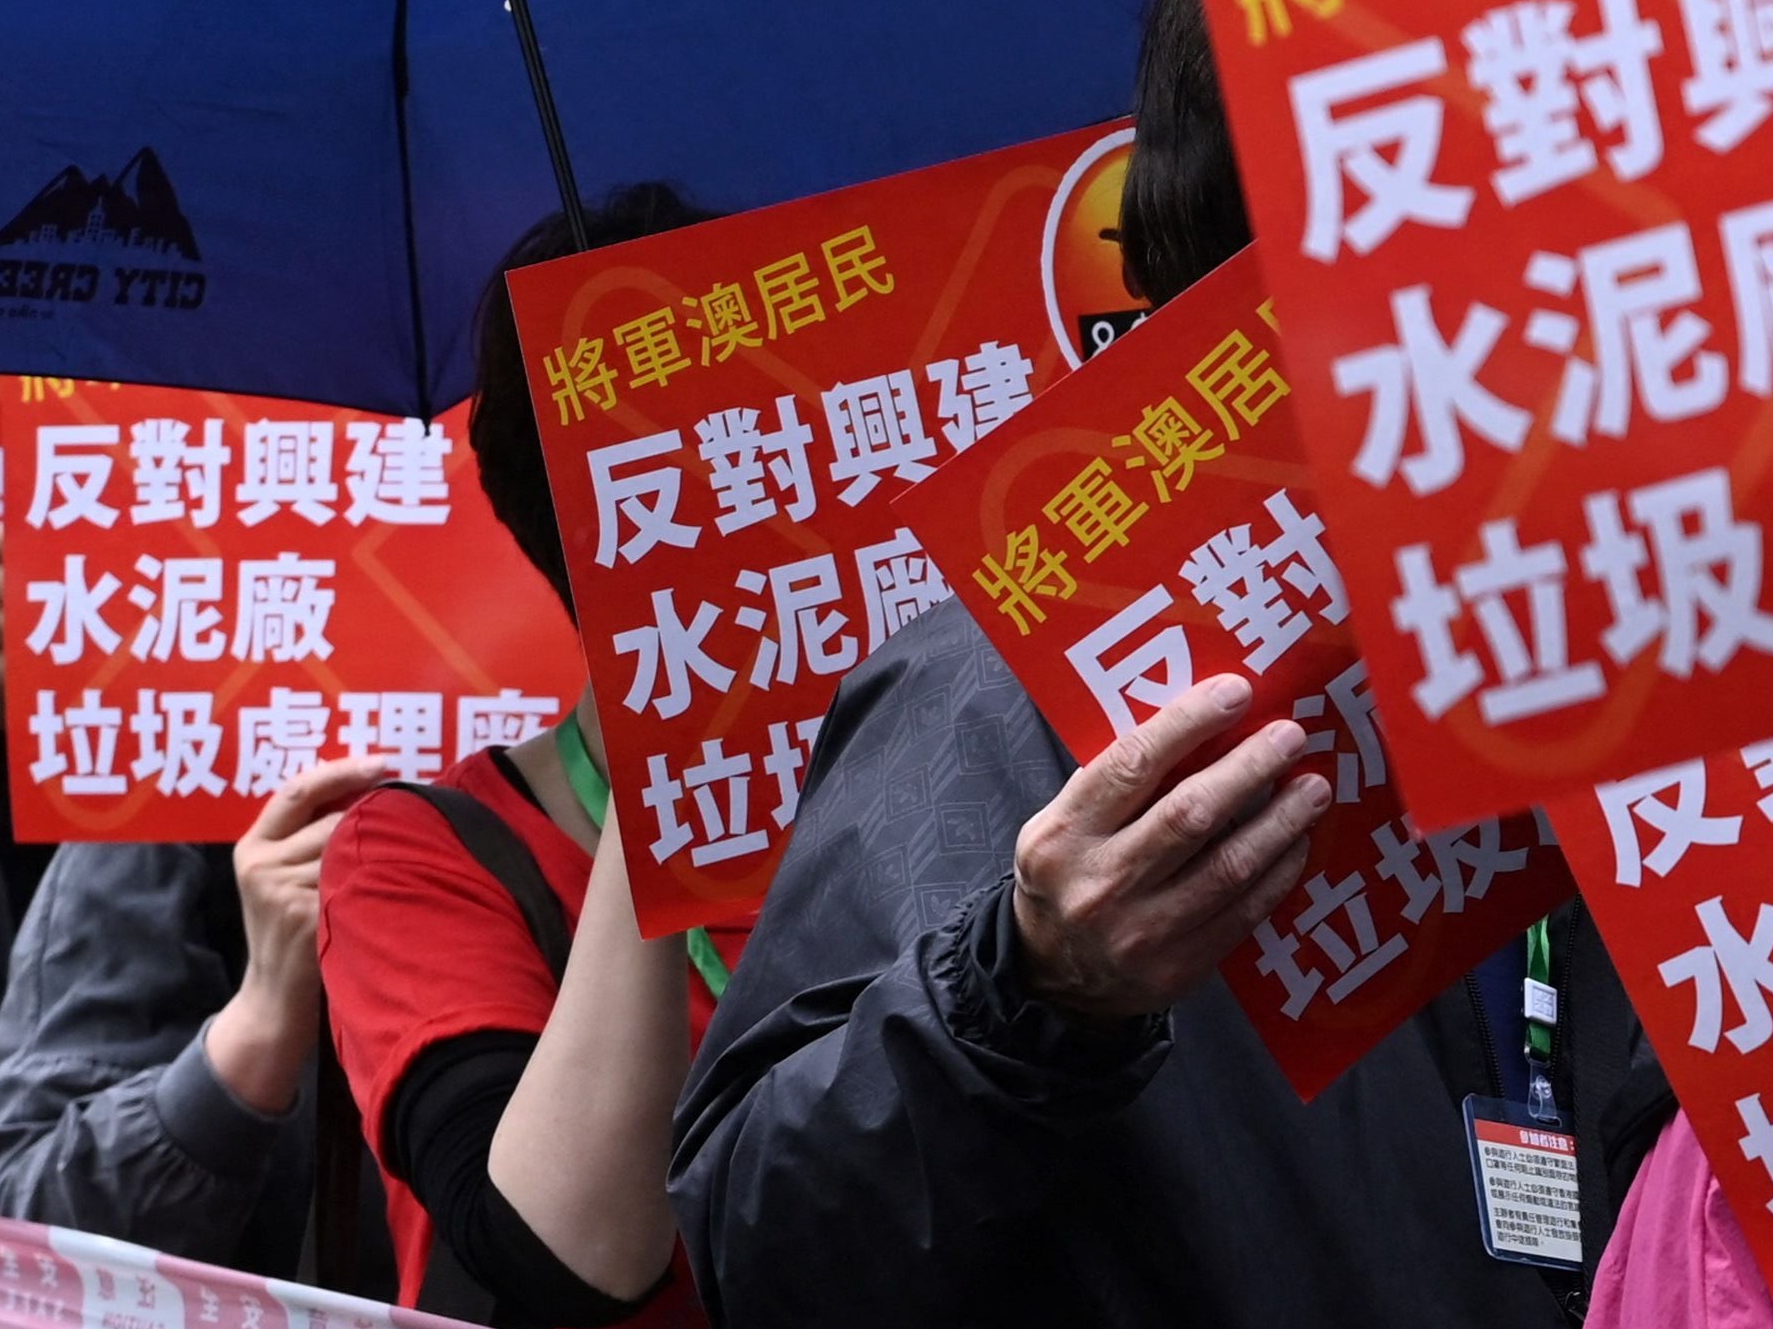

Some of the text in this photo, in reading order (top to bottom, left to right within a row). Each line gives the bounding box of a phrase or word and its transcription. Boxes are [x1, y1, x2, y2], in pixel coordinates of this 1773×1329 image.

[542, 225, 895, 425] 將軍澳居民
[26, 418, 451, 528] 反對興建
[584, 341, 1035, 568] 反對興建
[26, 552, 336, 665] 水泥廠
